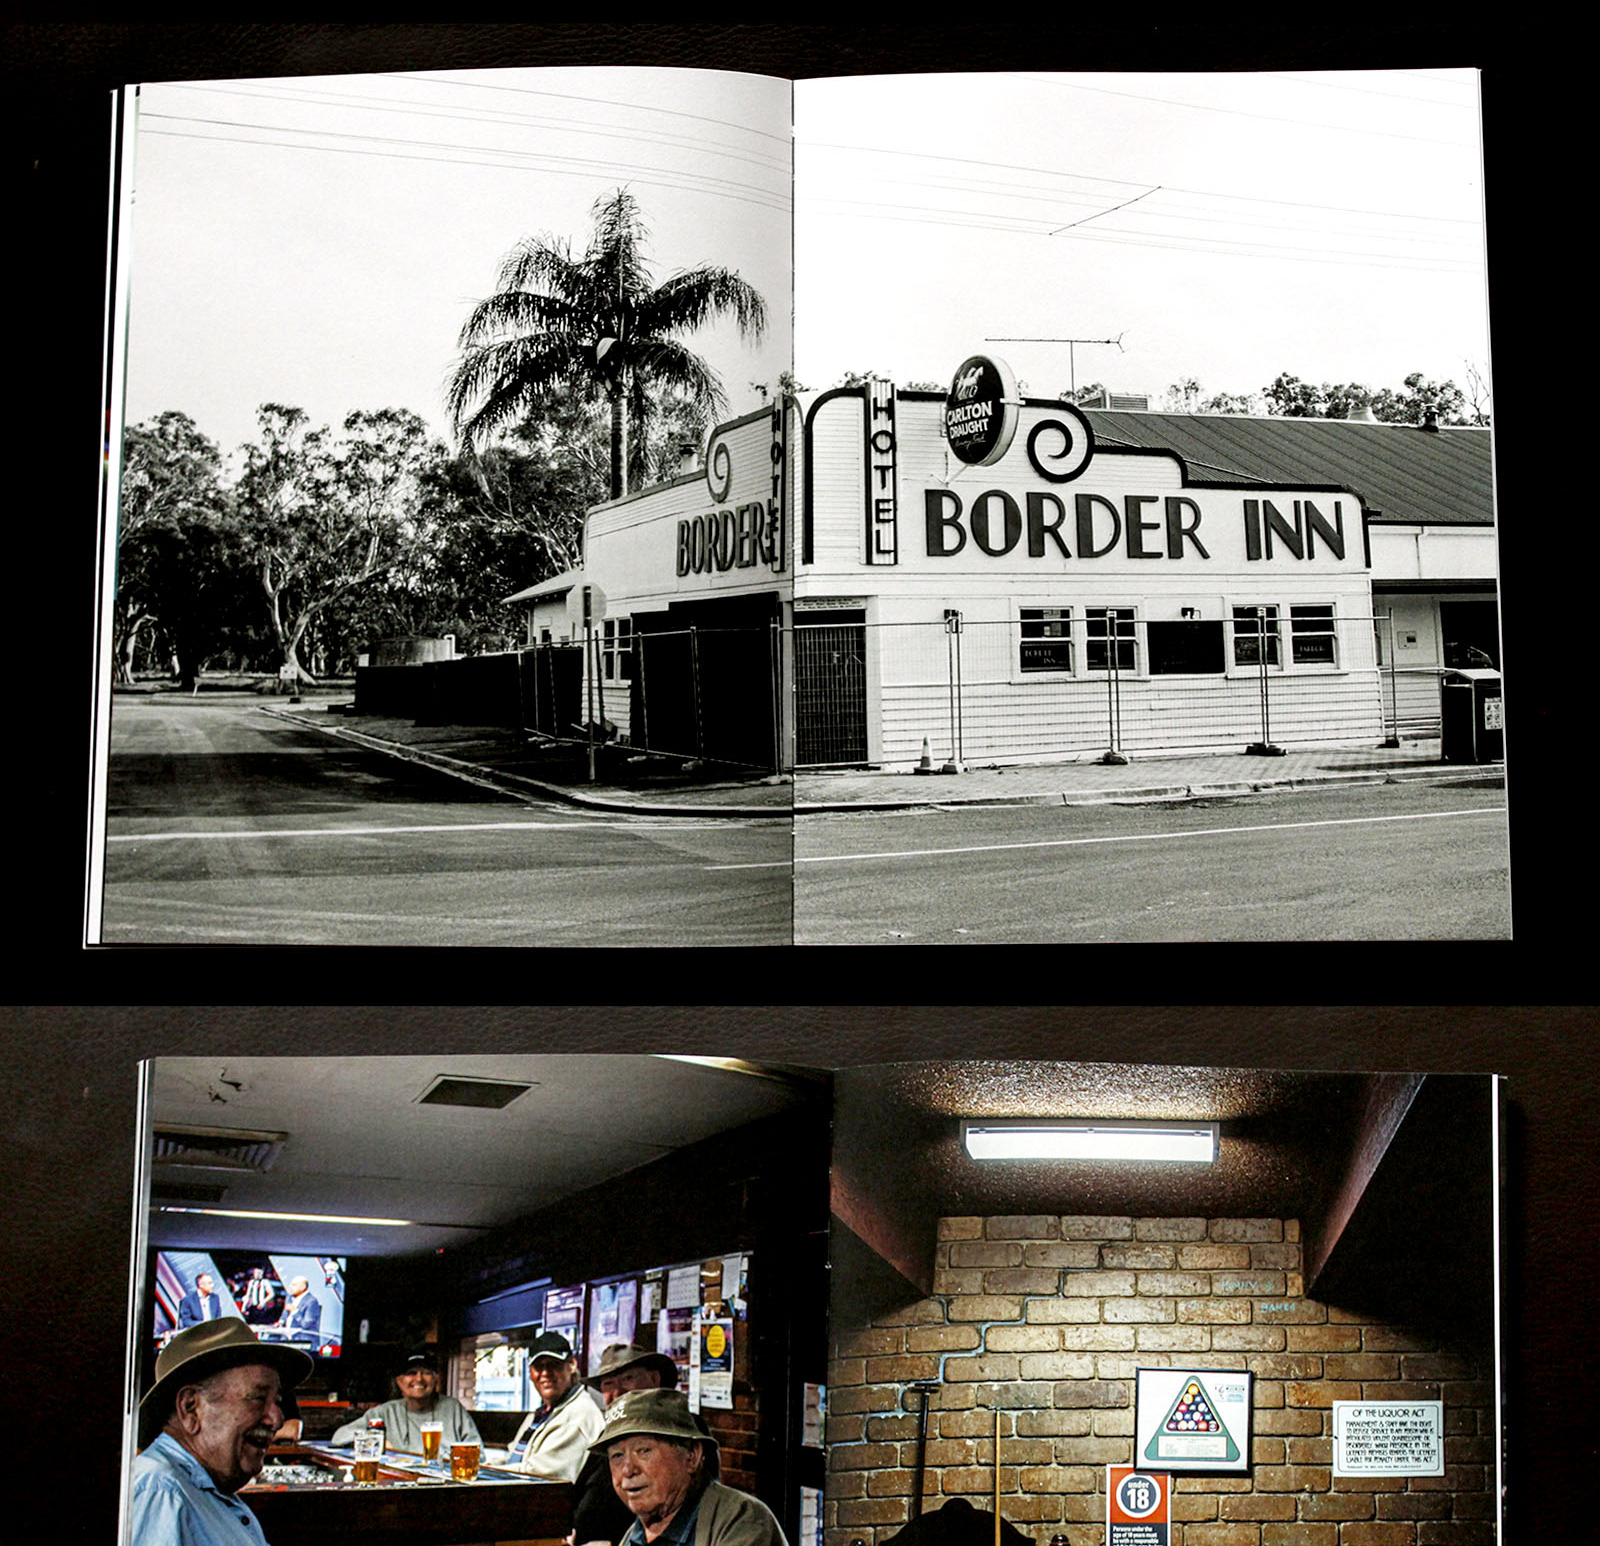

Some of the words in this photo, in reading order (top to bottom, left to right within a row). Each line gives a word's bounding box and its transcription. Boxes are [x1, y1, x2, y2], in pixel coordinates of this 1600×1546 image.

[947, 400, 993, 426] CARLTON
[949, 417, 989, 439] DRAUGHT
[871, 407, 896, 555] HOTEL
[924, 488, 1210, 561] BORDER
[1242, 498, 1346, 562] INN
[676, 501, 769, 578] BORDER
[1352, 1409, 1362, 1417] OF
[1365, 1409, 1377, 1417] THE
[1378, 1409, 1410, 1418] LIQUOR
[1411, 1409, 1425, 1417] ACT
[1128, 1480, 1150, 1489] under
[1127, 1488, 1150, 1510] 18
